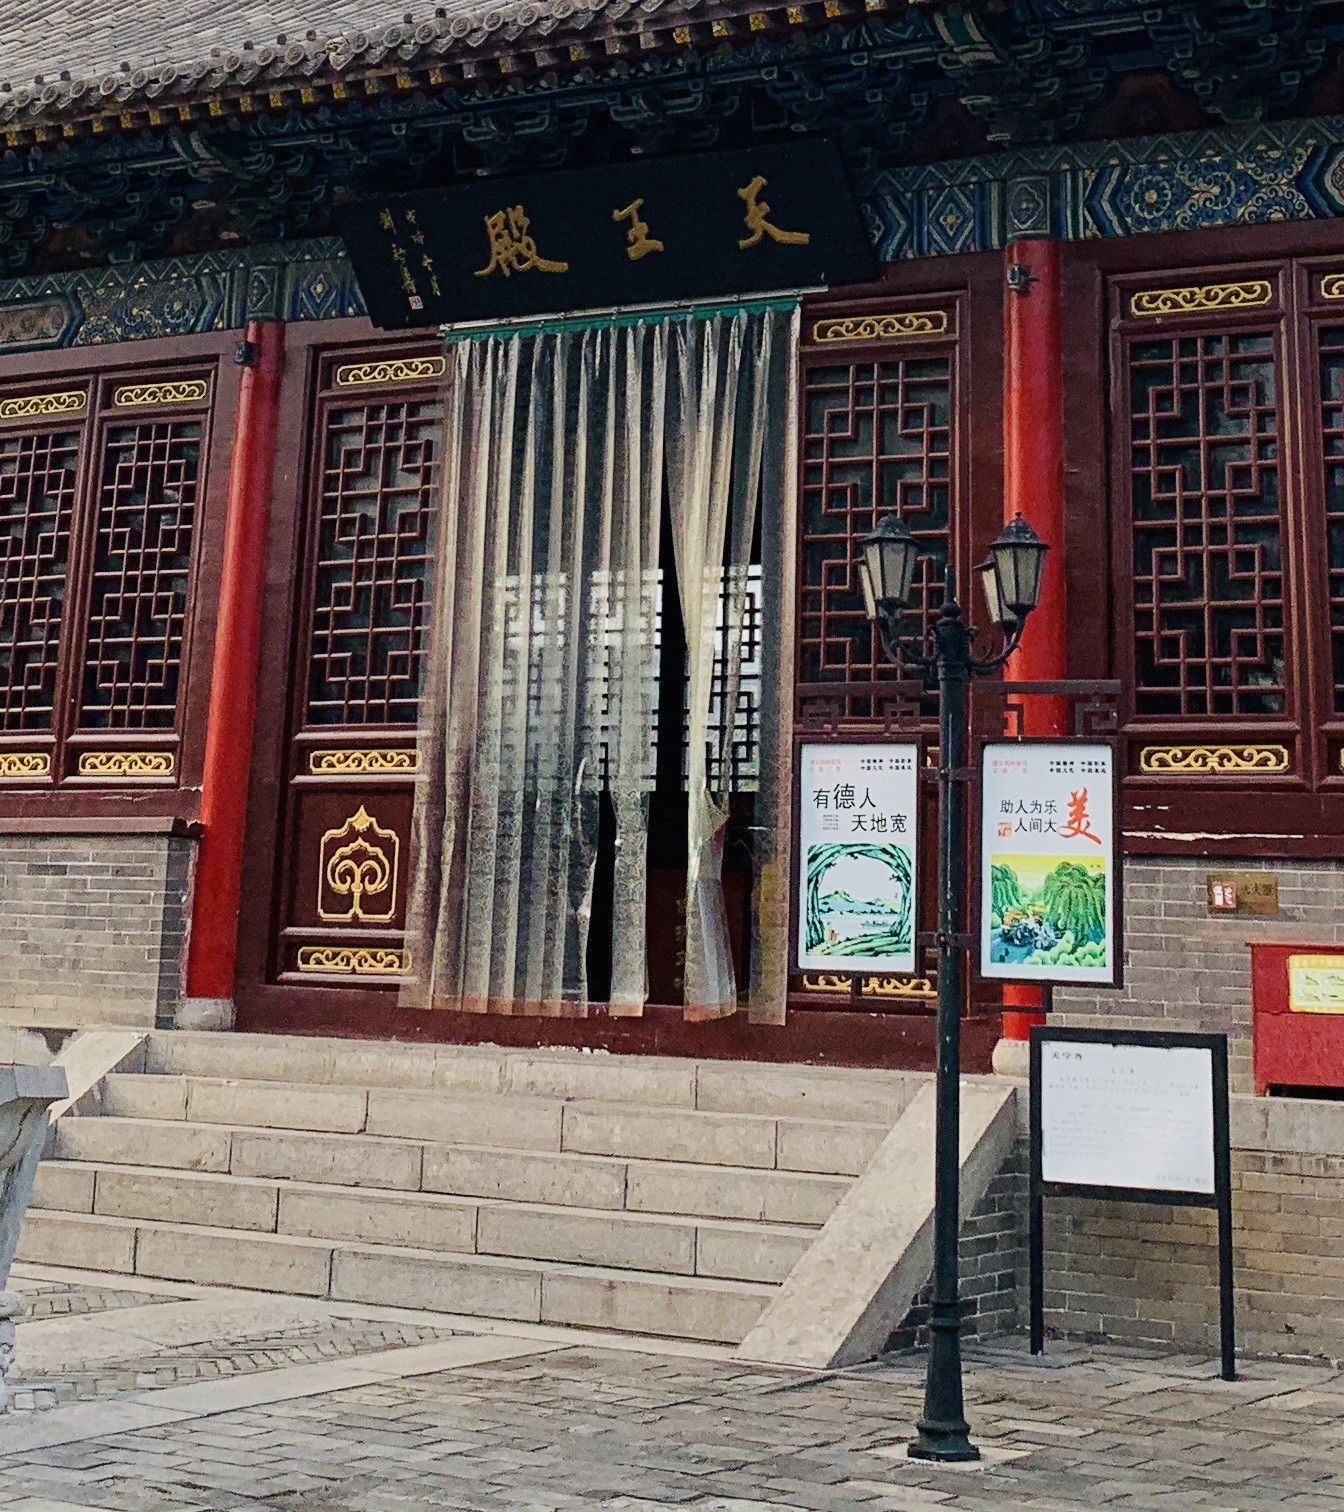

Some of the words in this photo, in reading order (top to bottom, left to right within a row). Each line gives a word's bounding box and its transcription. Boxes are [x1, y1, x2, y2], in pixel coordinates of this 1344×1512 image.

[474, 175, 810, 277] 天王殿
[812, 783, 876, 810] 有德人
[999, 799, 1058, 814] 助人为乐
[851, 813, 908, 834] 天地宽
[1014, 817, 1058, 833] 人间大
[1058, 786, 1102, 845] 美
